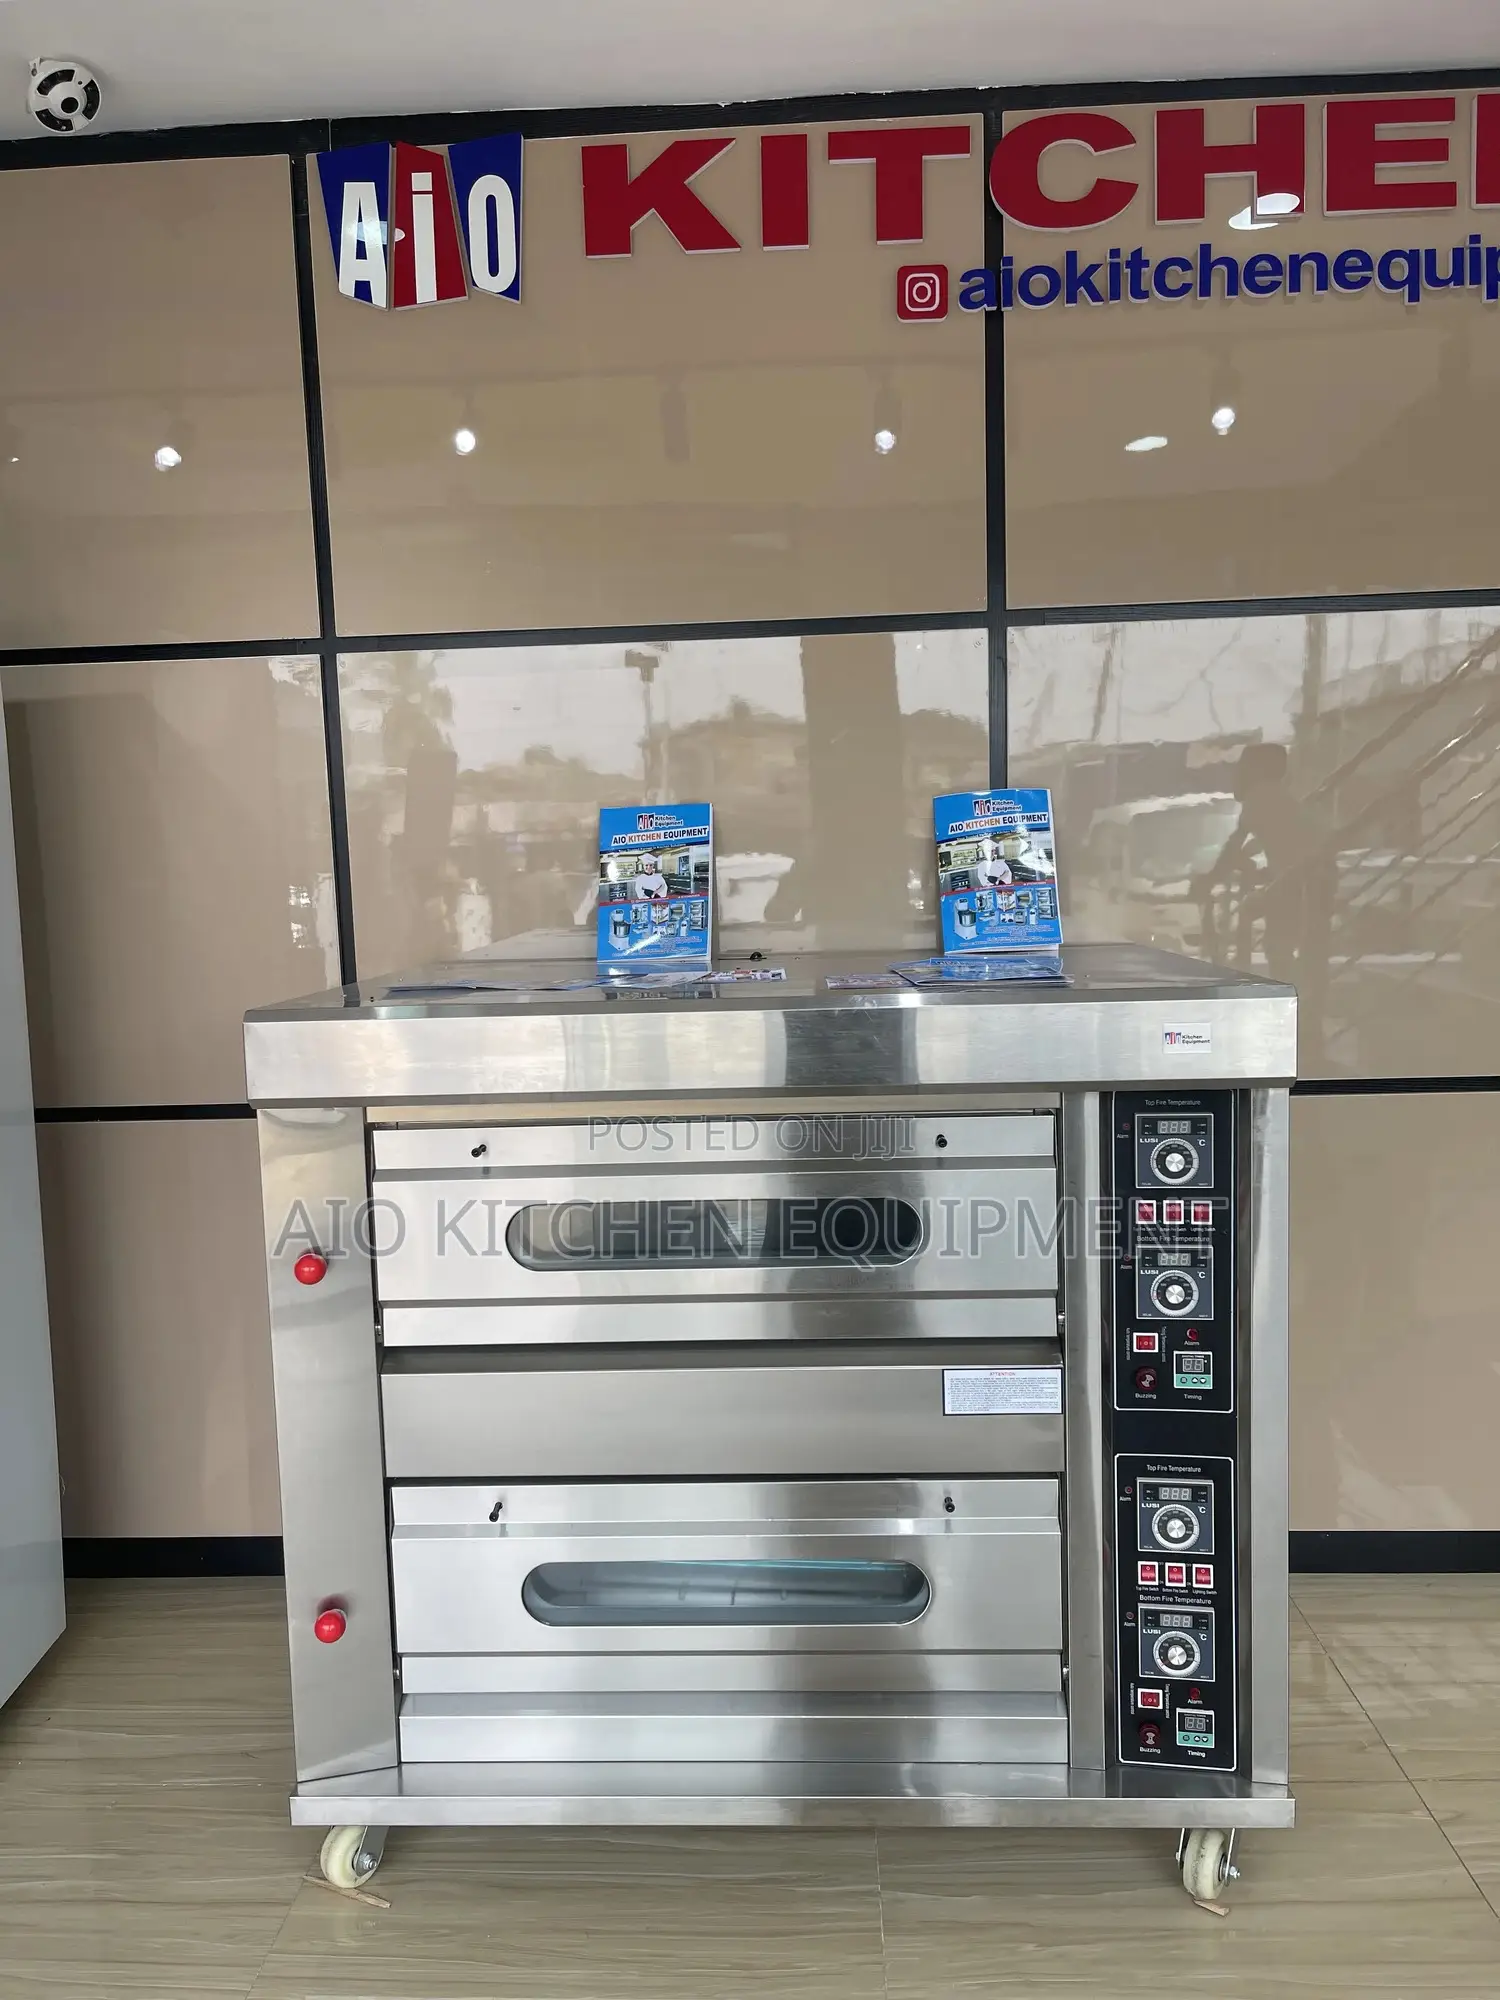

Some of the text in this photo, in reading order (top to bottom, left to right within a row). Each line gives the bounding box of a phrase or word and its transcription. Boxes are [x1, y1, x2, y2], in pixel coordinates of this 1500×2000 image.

[581, 93, 1500, 258] KITCHE
[950, 814, 1047, 832] AIO KITCHEN EQUIPMENT
[613, 827, 708, 845] AIO KITCHEN EQUIPMENT
[1168, 1465, 1201, 1473] Temperature
[1175, 1596, 1212, 1604] Temperature
